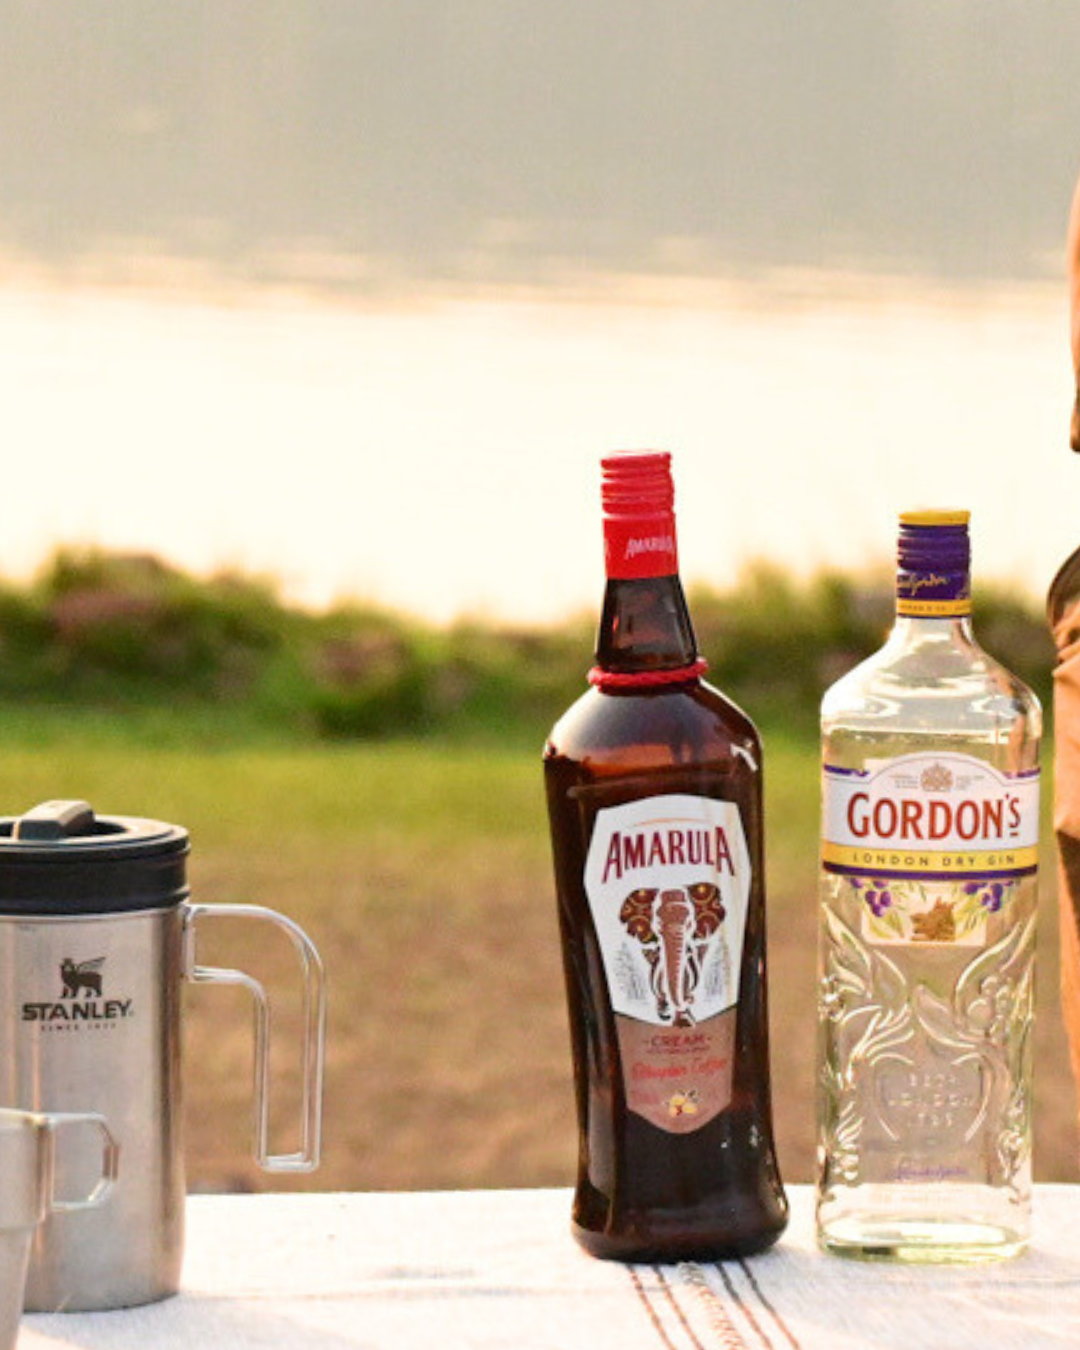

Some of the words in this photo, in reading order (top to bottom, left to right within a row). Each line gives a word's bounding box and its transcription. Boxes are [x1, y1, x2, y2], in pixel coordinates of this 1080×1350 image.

[847, 791, 1022, 840] GORDON'S
[602, 826, 736, 884] AMARULA
[853, 852, 930, 866] LONDON
[942, 853, 976, 866] DRY
[987, 853, 1016, 865] GIN
[21, 999, 132, 1021] STANLEY
